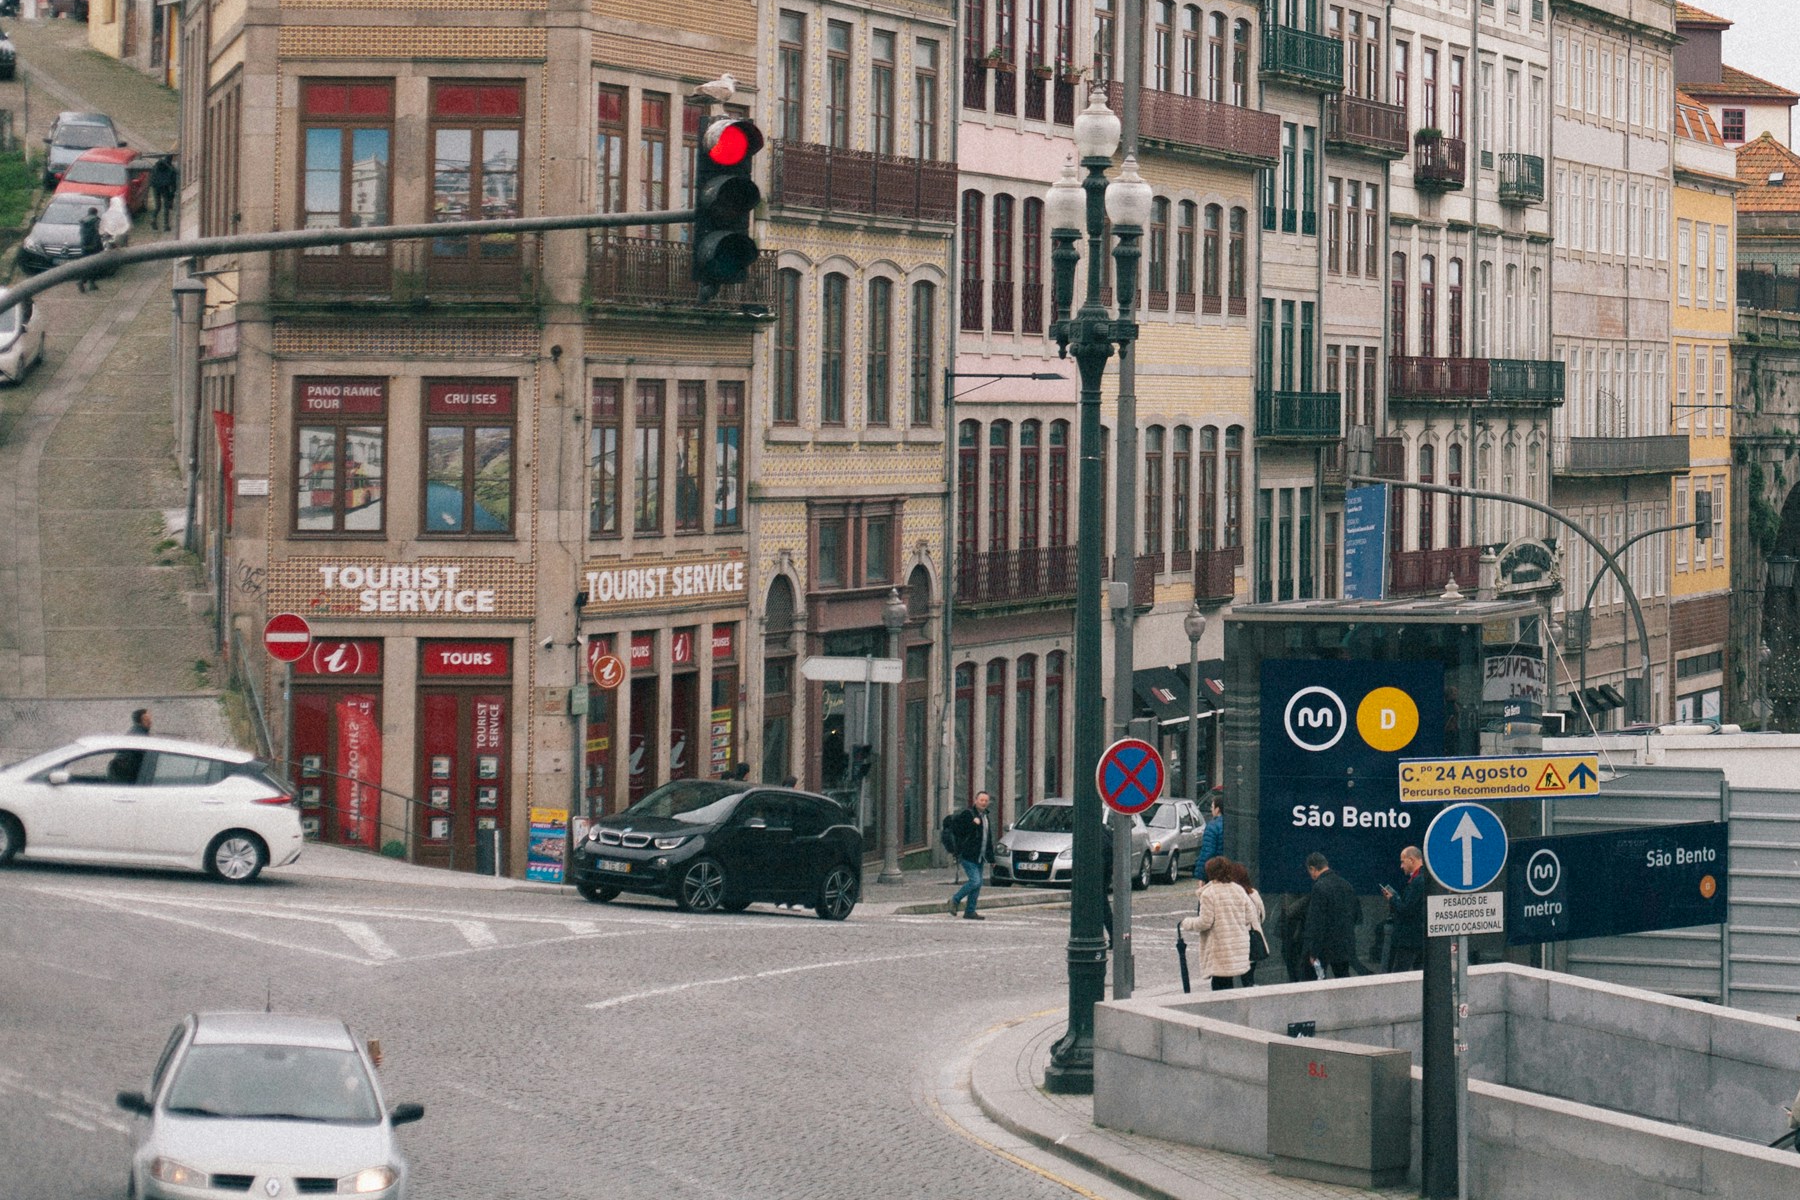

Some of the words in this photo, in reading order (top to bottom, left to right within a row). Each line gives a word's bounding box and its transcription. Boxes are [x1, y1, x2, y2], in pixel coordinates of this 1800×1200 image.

[307, 399, 340, 409] TOUR
[319, 567, 461, 589] TOURIST
[586, 567, 668, 603] TOURIST
[672, 561, 744, 597] SERVICE
[360, 590, 494, 612] SERVICE
[440, 652, 493, 666] TOURS
[477, 703, 487, 749] TOURIST
[490, 703, 500, 748] SERVICE
[1380, 708, 1396, 730] D
[1436, 767, 1456, 781] 24
[1461, 765, 1528, 782] Agosto
[1403, 787, 1450, 797] Percurso
[1453, 784, 1530, 795] Recomendado
[1292, 804, 1335, 827] São
[1343, 806, 1411, 828] Bento
[1647, 849, 1672, 867] São
[1676, 847, 1716, 865] Bento
[1443, 897, 1476, 907] PESADOS
[1478, 896, 1488, 904] DE
[1524, 901, 1562, 917] metro
[1435, 910, 1484, 920] PASSAGEIROS
[1486, 908, 1496, 916] EM
[1429, 924, 1460, 934] SERVIÇO
[1462, 920, 1502, 931] OCASIONAL
